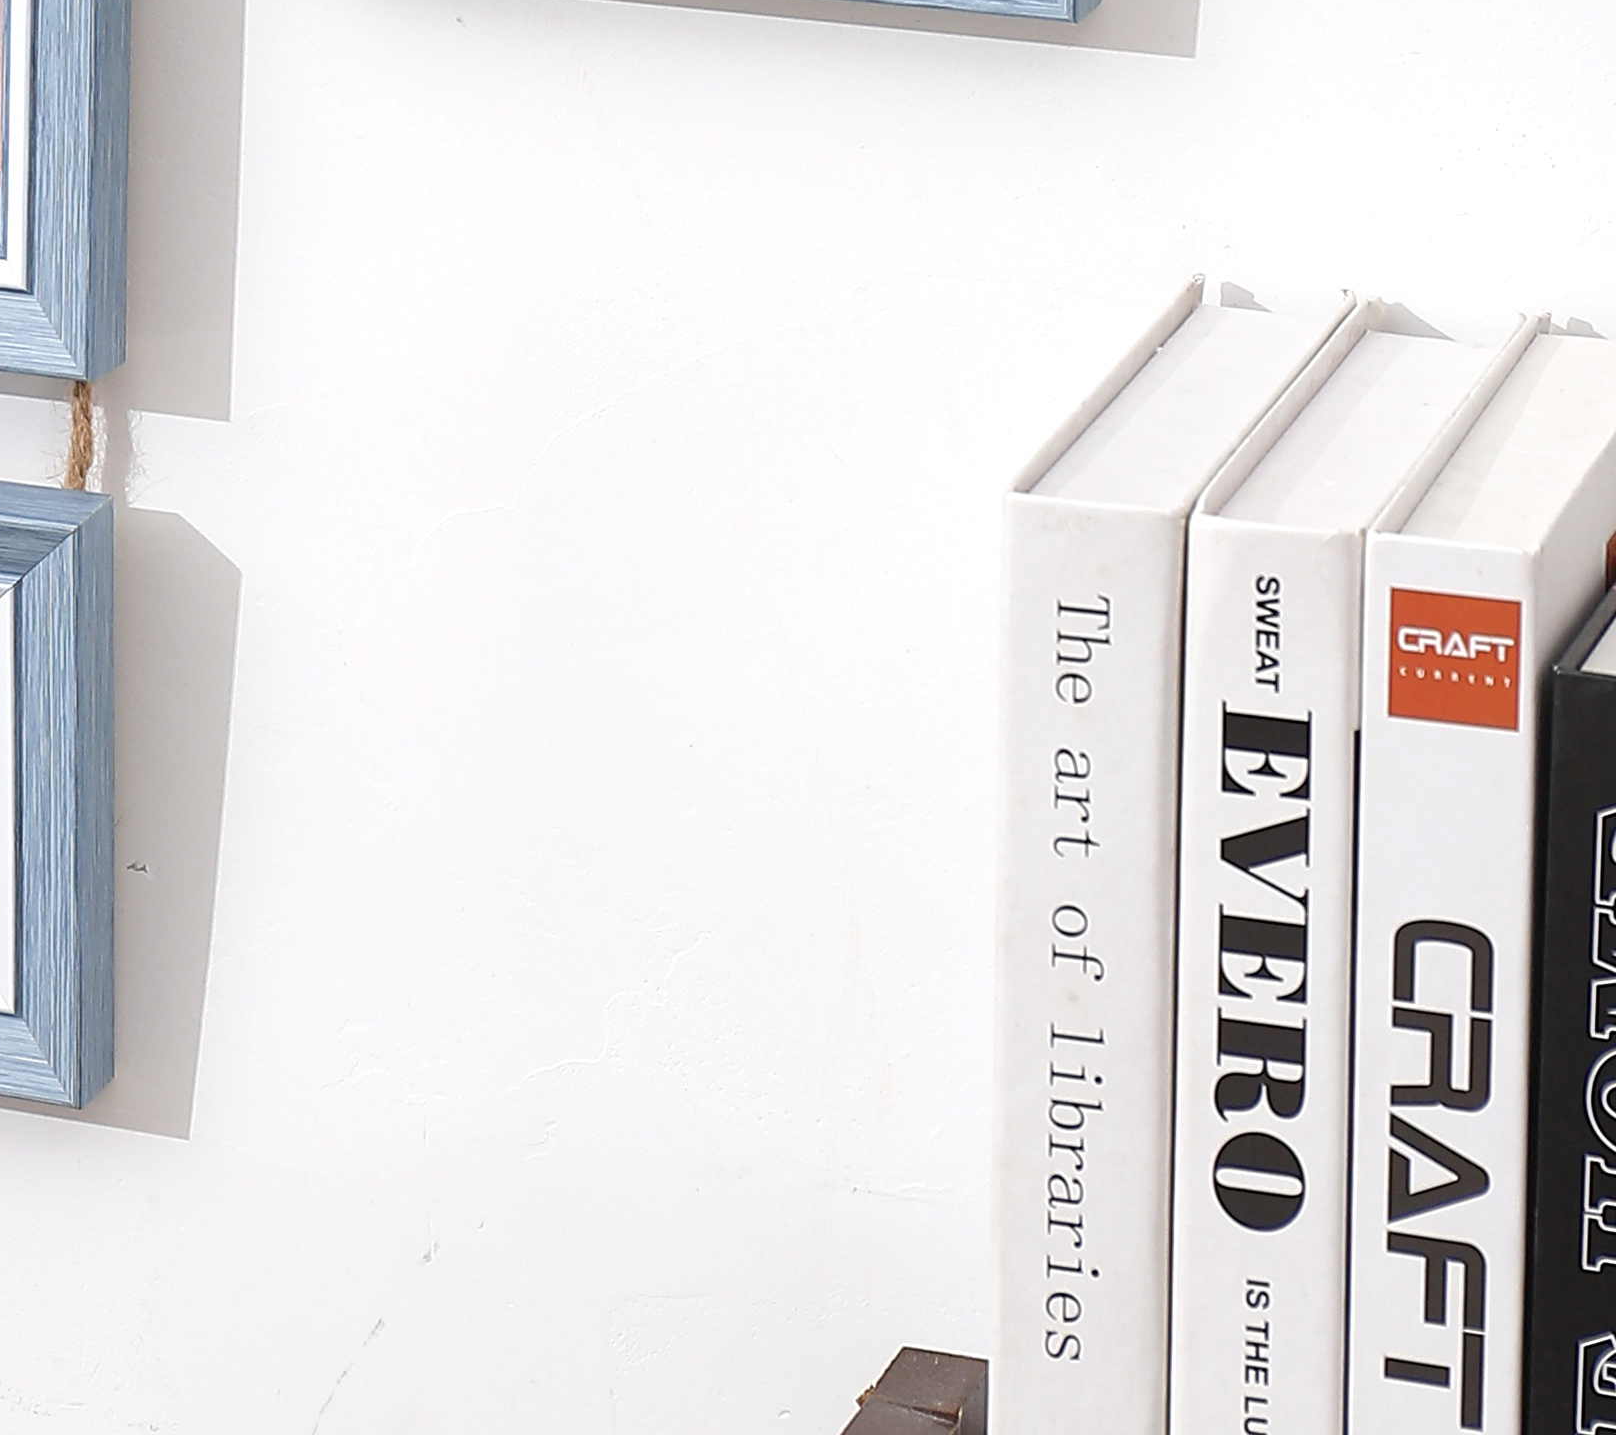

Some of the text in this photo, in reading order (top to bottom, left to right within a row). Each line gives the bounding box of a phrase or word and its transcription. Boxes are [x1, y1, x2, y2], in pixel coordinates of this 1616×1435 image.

[1254, 575, 1281, 694] SWEAT
[1397, 625, 1515, 663] CRAFT
[1398, 665, 1512, 689] CURRENT
[1044, 594, 1112, 1362] The art of libraries
[1212, 700, 1313, 1233] EVERO
[1383, 918, 1495, 1432] CRAFT
[1244, 1278, 1270, 1310] IS
[1243, 1320, 1270, 1386] THE
